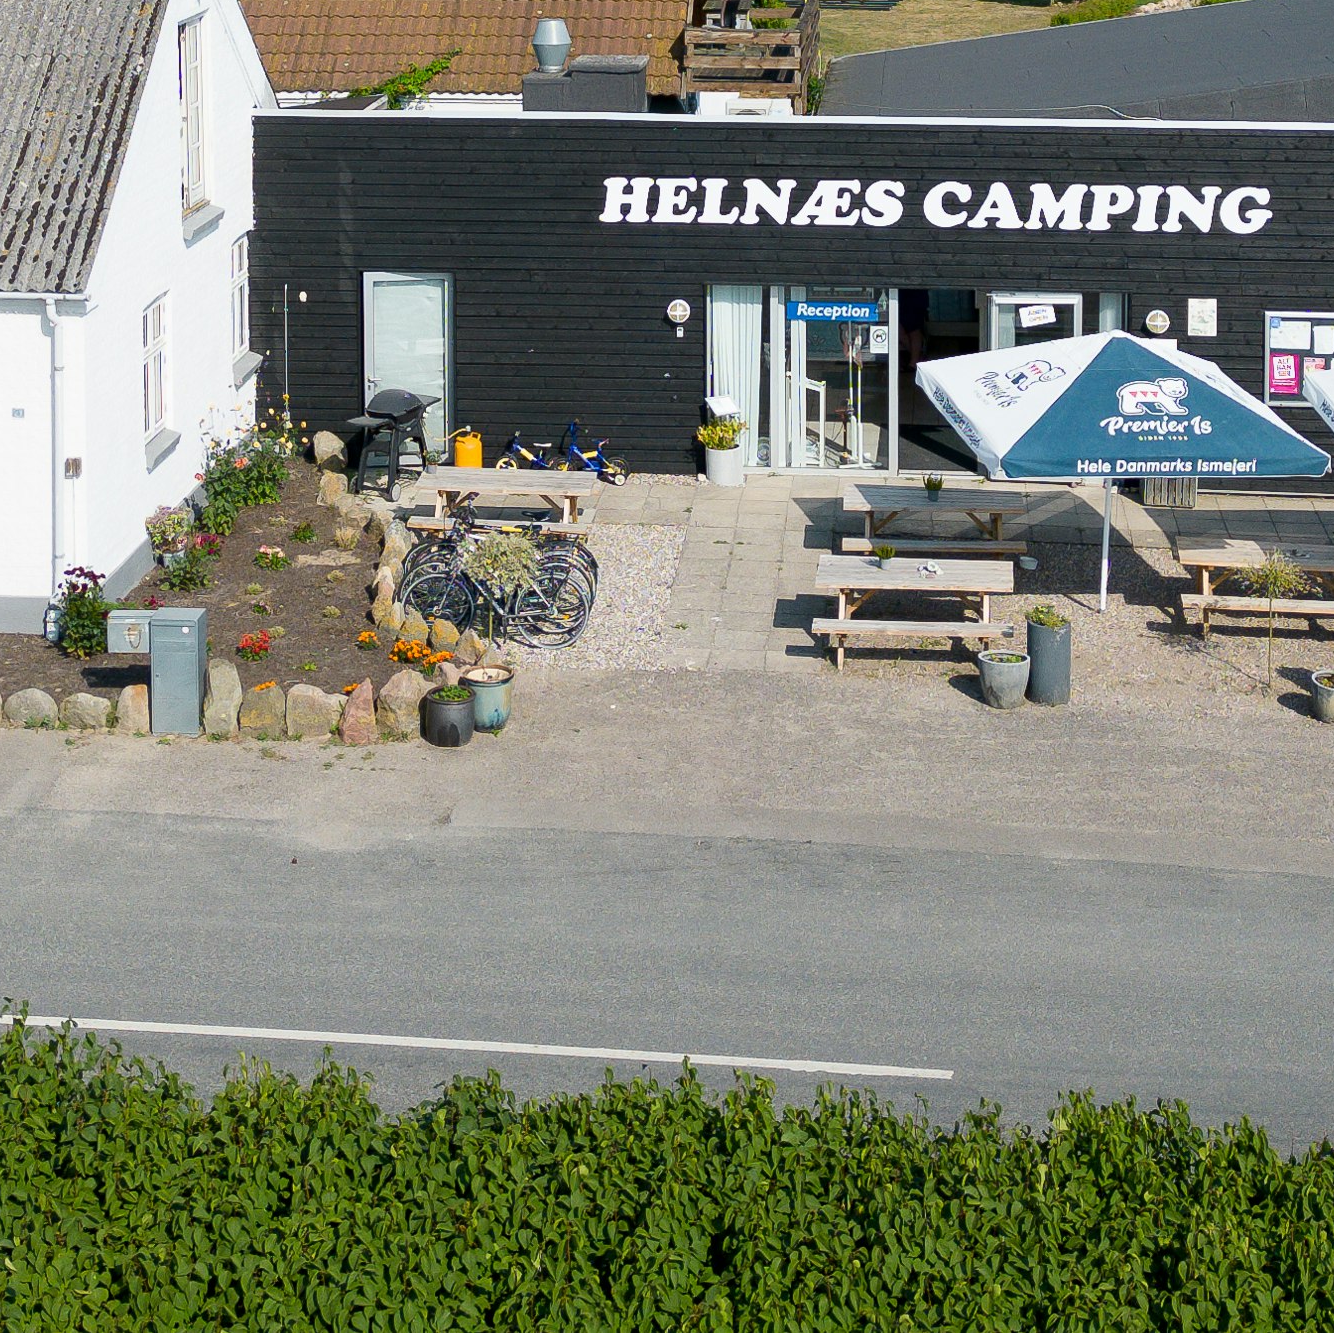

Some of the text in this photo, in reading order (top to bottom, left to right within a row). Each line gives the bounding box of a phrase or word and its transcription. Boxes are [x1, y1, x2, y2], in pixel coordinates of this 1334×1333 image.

[599, 176, 1274, 235] HELNÆS CAMPING
[796, 302, 870, 320] Reception
[1099, 415, 1213, 436] Premier Is
[1076, 457, 1257, 475] Hele Danmarks Ismejeri
